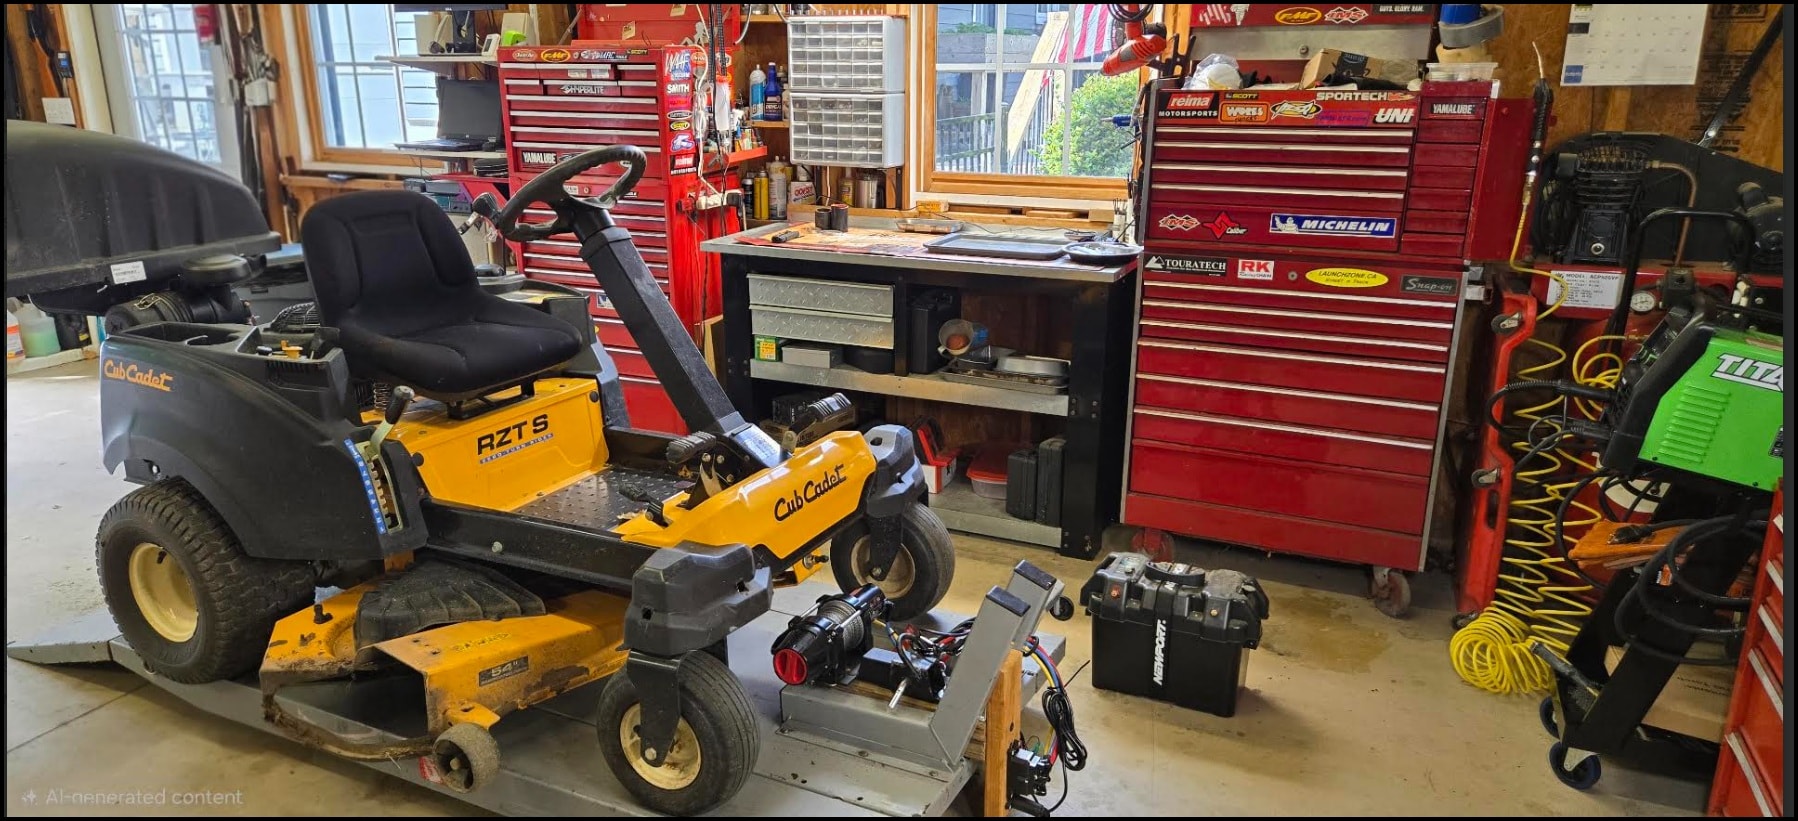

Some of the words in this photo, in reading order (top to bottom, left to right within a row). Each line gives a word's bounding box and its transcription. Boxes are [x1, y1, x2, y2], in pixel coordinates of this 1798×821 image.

[1279, 11, 1318, 20] FMF
[667, 83, 690, 94] SMITH
[1169, 94, 1212, 107] reima
[1316, 92, 1388, 101] SPORTECH
[1158, 109, 1218, 117] MOTORSPORTS
[1432, 104, 1473, 115] YAMALUBE
[522, 151, 557, 164] YAMALUBE
[1301, 220, 1390, 232] MICHELIN
[1165, 259, 1227, 270] TOURATECH
[1240, 261, 1272, 273] RK
[1319, 270, 1377, 279] LAUNCHZONE.CA
[1405, 278, 1453, 291] Snap-on
[103, 359, 126, 380] Cub
[126, 364, 173, 391] Cadet
[477, 420, 528, 456] RZT
[532, 413, 549, 435] S
[774, 489, 804, 522] Cub
[803, 464, 847, 503] Cadet
